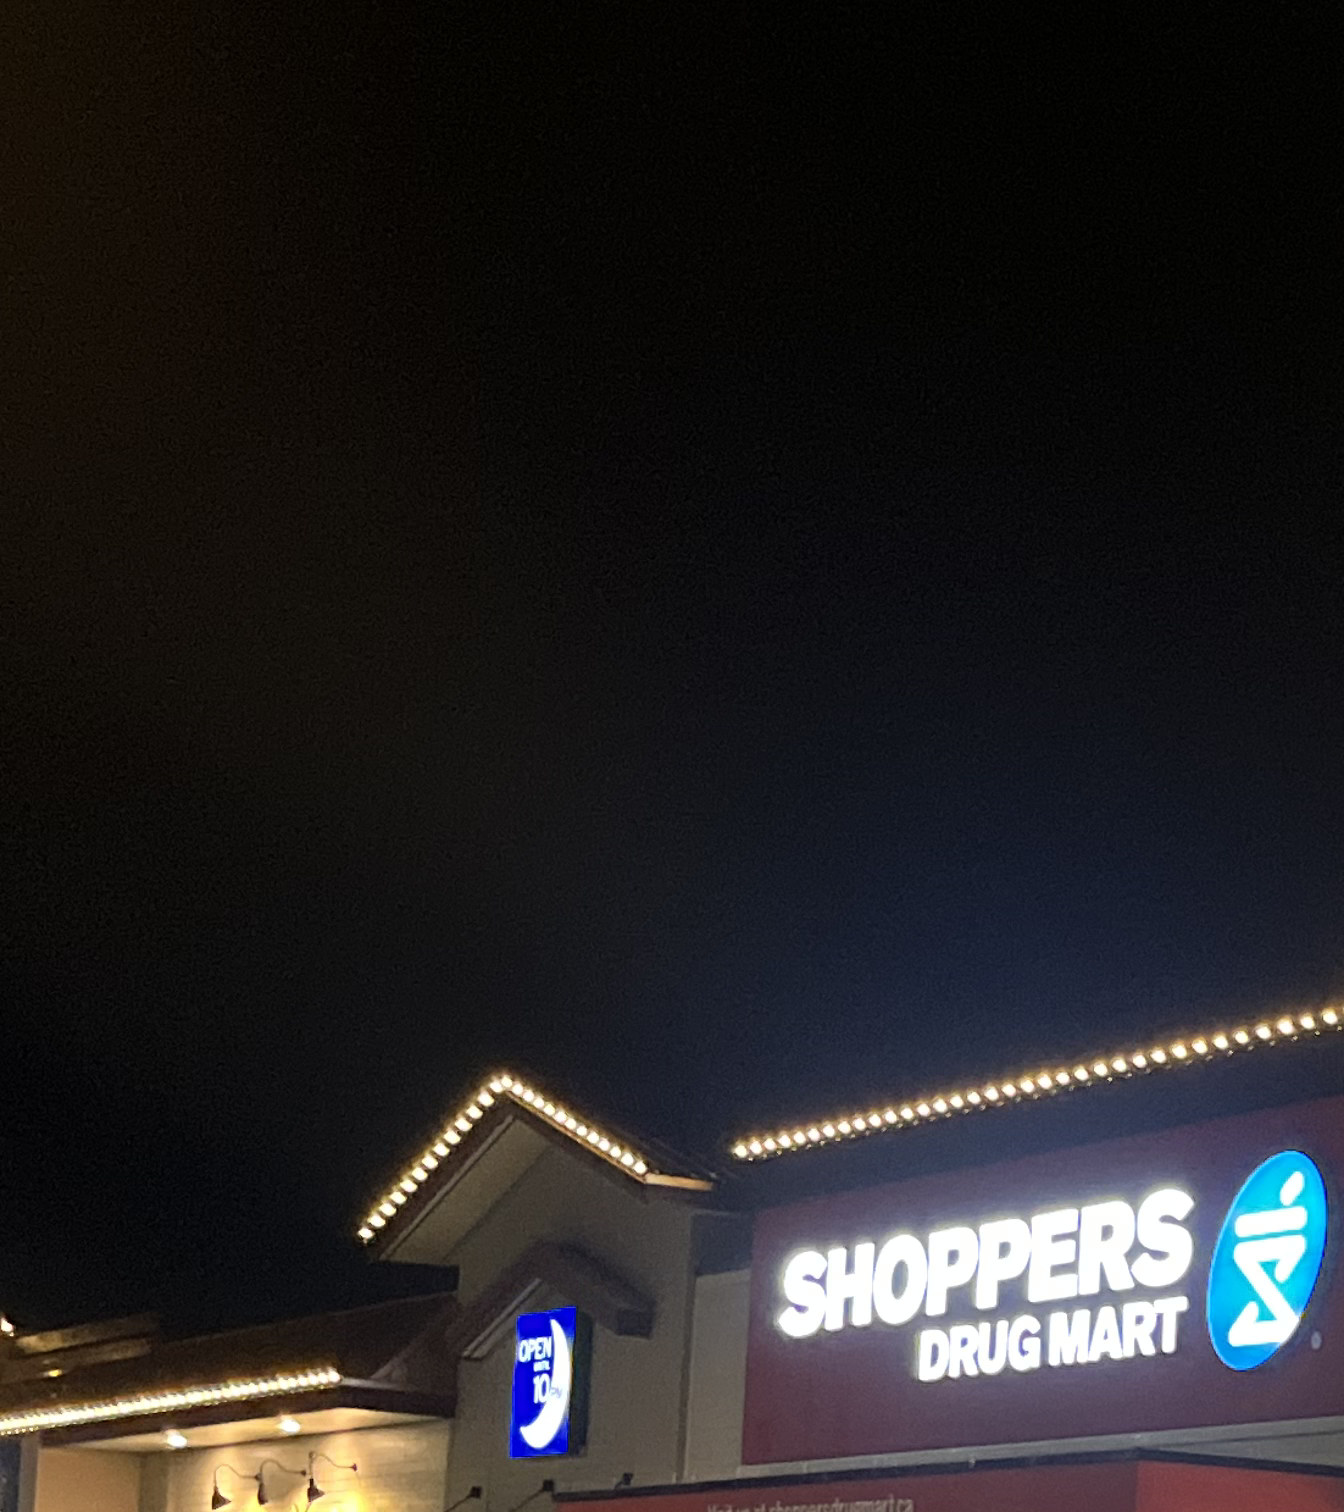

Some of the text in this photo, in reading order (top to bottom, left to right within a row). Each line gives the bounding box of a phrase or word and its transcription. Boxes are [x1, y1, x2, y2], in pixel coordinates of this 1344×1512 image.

[777, 1189, 1196, 1339] SHOPPERS
[519, 1336, 552, 1362] OPEN
[917, 1296, 1189, 1383] DRUG MART
[533, 1373, 551, 1404] 10
